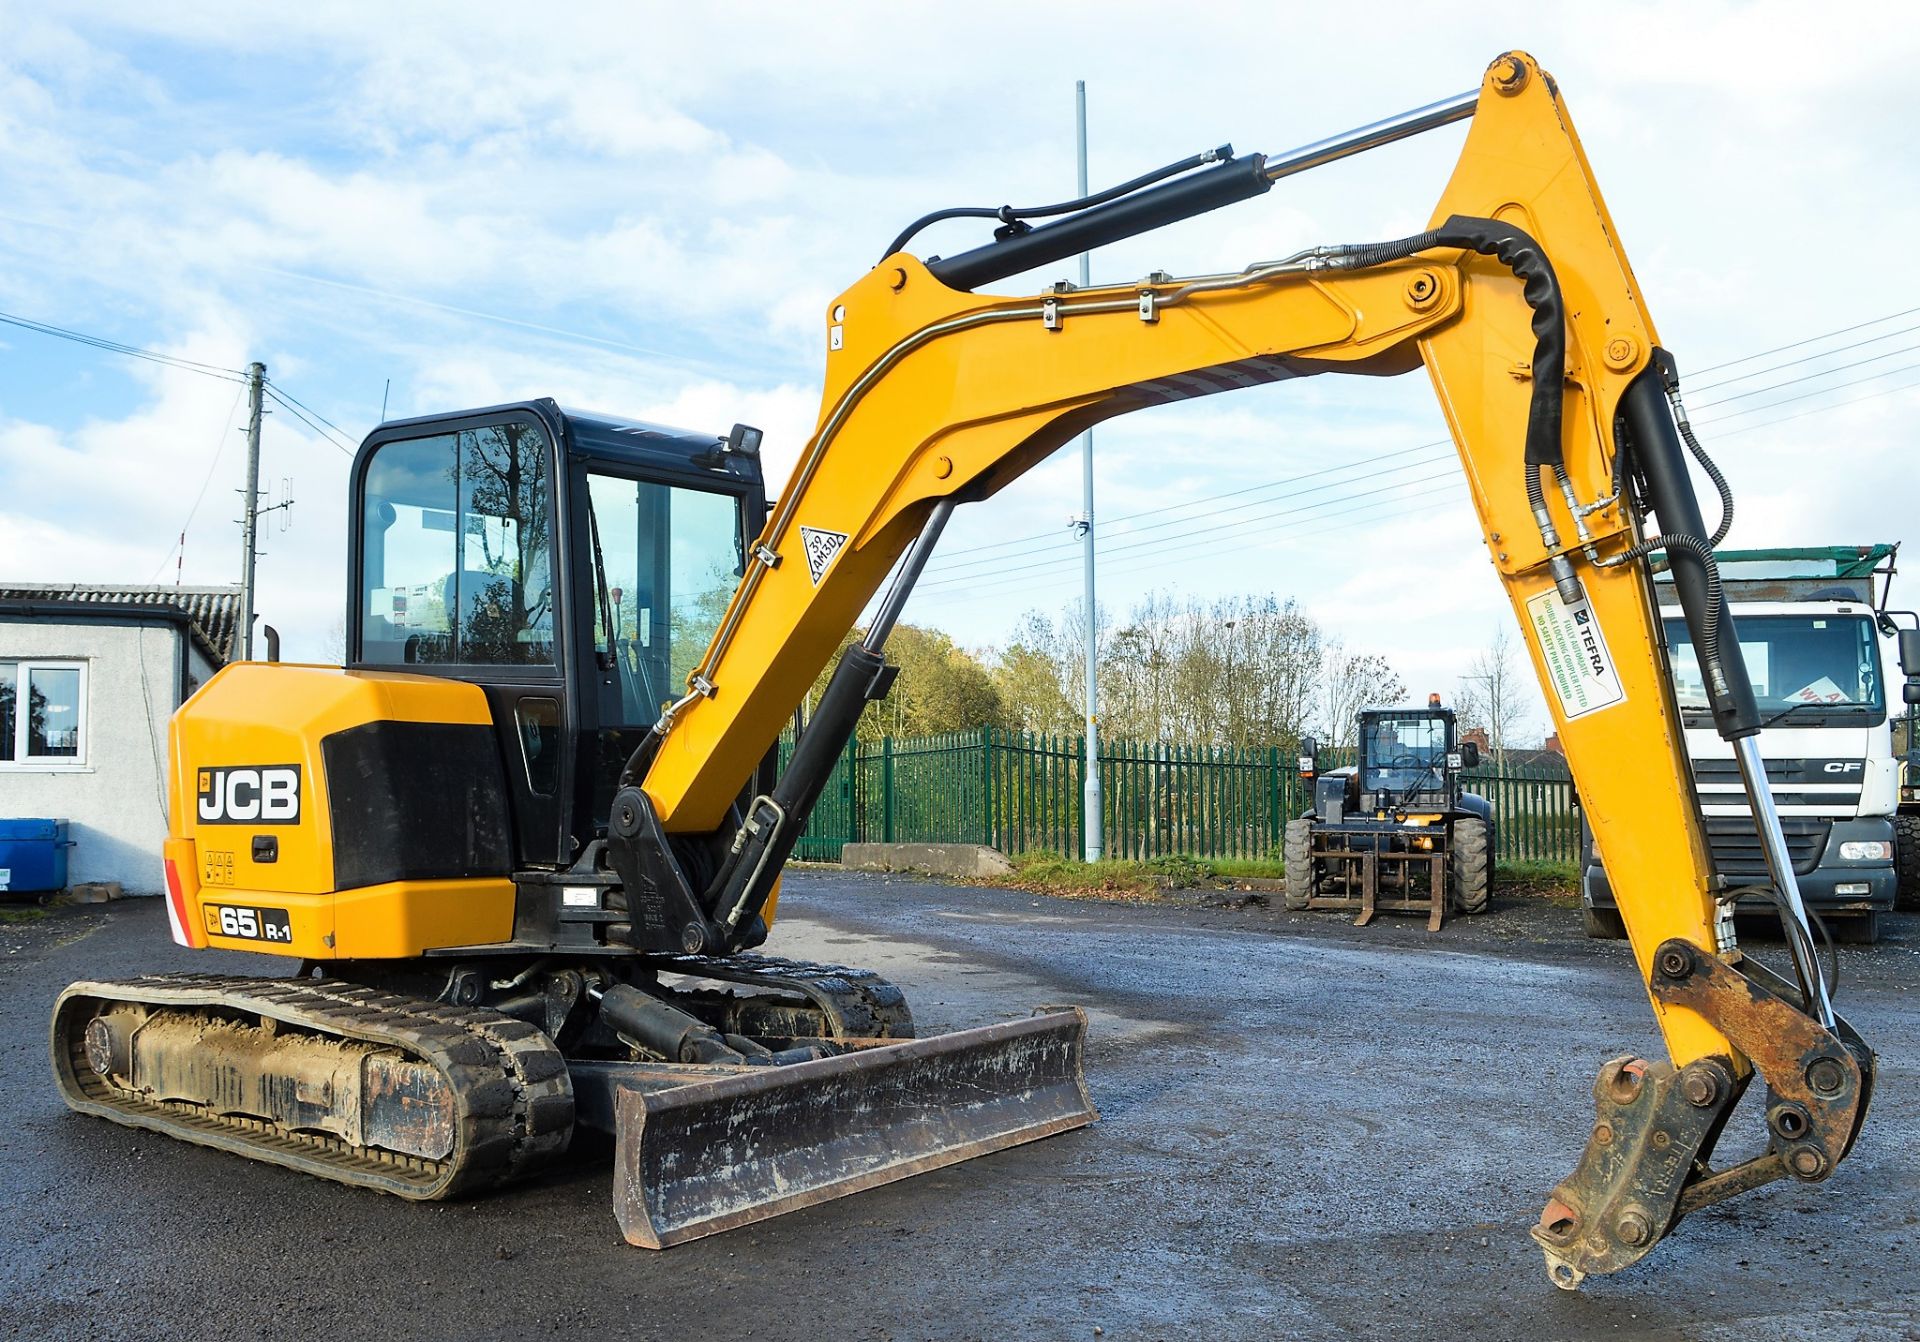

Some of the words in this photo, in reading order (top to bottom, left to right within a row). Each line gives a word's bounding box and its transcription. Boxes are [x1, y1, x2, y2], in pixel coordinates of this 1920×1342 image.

[809, 535, 823, 554] 39
[1537, 615, 1546, 626] NO
[1540, 626, 1555, 651] SAFETY
[1543, 599, 1558, 625] DOUBLE
[1553, 625, 1568, 655] LOCKING
[1563, 654, 1580, 684] COUPLER
[1575, 684, 1588, 708] FITTED
[1563, 619, 1576, 640] FULLY
[1571, 640, 1590, 678] AUTOMATIC
[1581, 626, 1605, 677] TEFRA
[1550, 651, 1560, 665] PIN
[1555, 664, 1572, 700] REQUIRED
[1824, 762, 1861, 773] CF
[199, 769, 299, 820] JCB
[220, 907, 258, 938] 65
[265, 923, 291, 941] R-1
